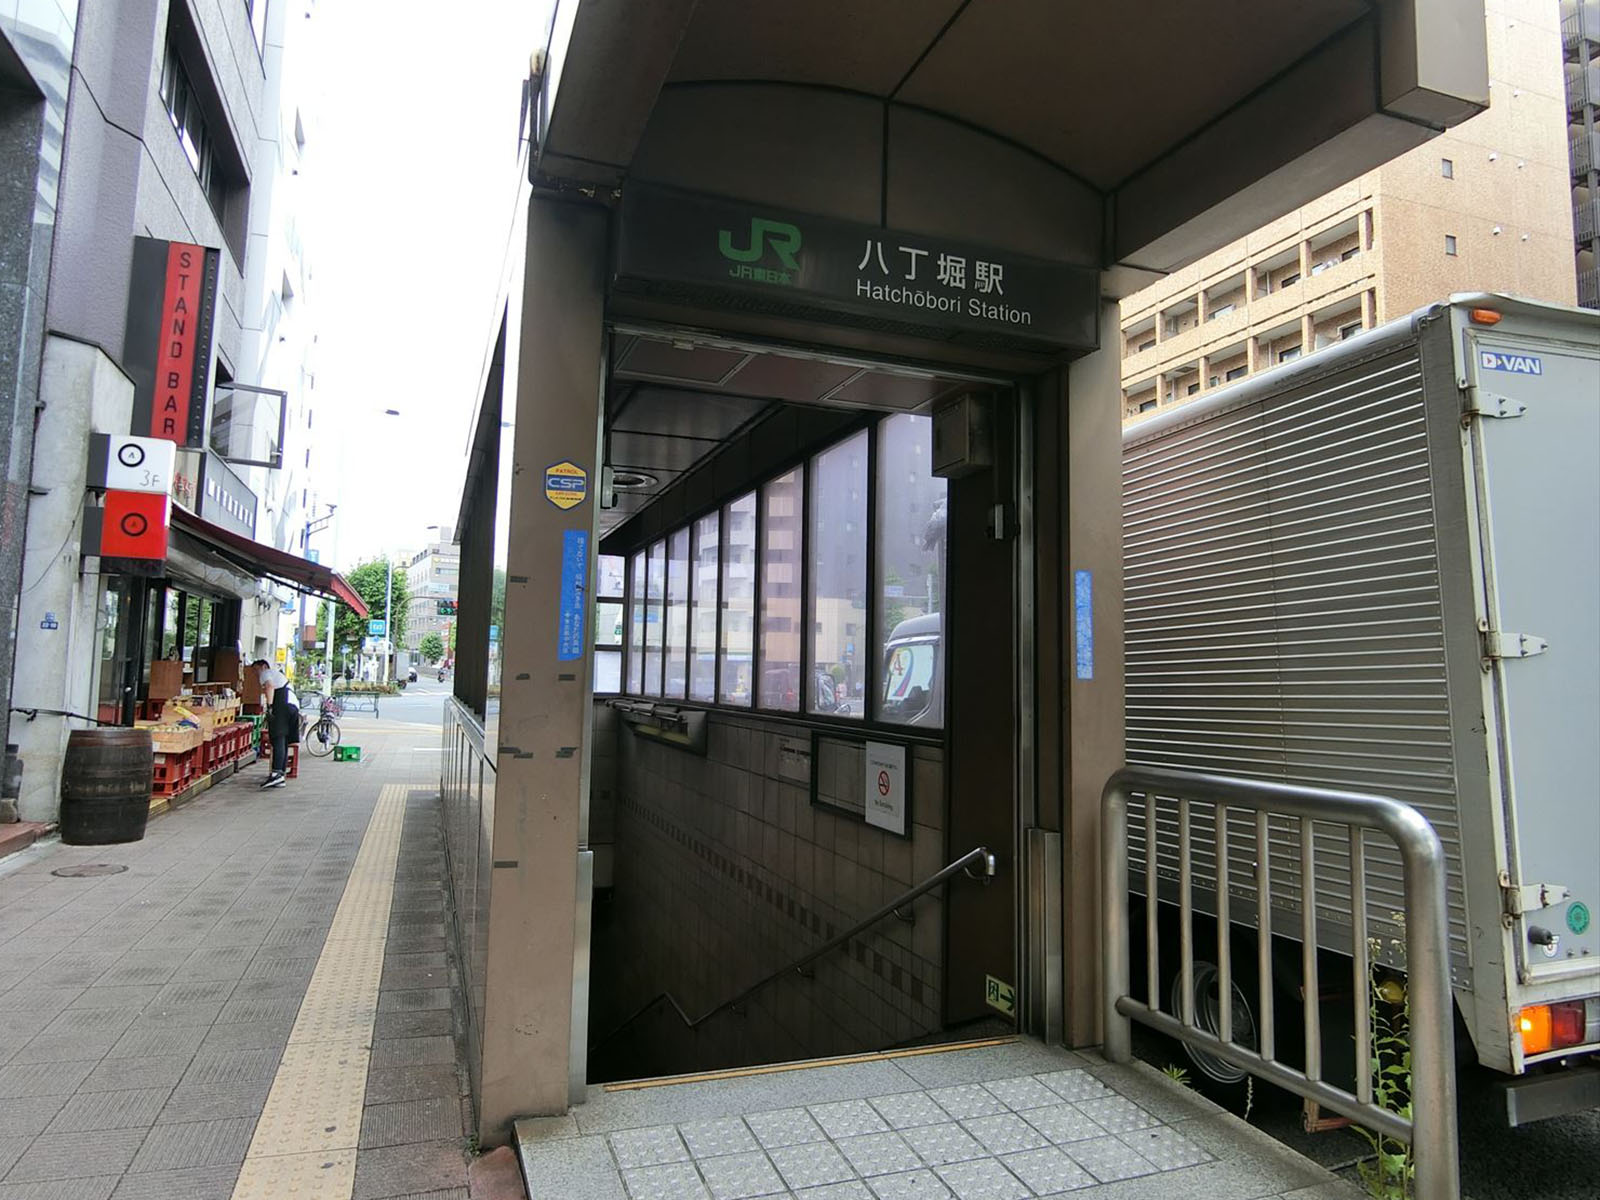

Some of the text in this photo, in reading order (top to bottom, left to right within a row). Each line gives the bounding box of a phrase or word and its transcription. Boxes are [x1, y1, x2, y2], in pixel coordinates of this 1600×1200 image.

[719, 217, 802, 272] JR
[857, 239, 1004, 296] 八丁堀駅
[968, 297, 1032, 326] Station
[162, 251, 192, 435] STAND BAR
[140, 469, 160, 488] 3F
[548, 477, 585, 489] CSP
